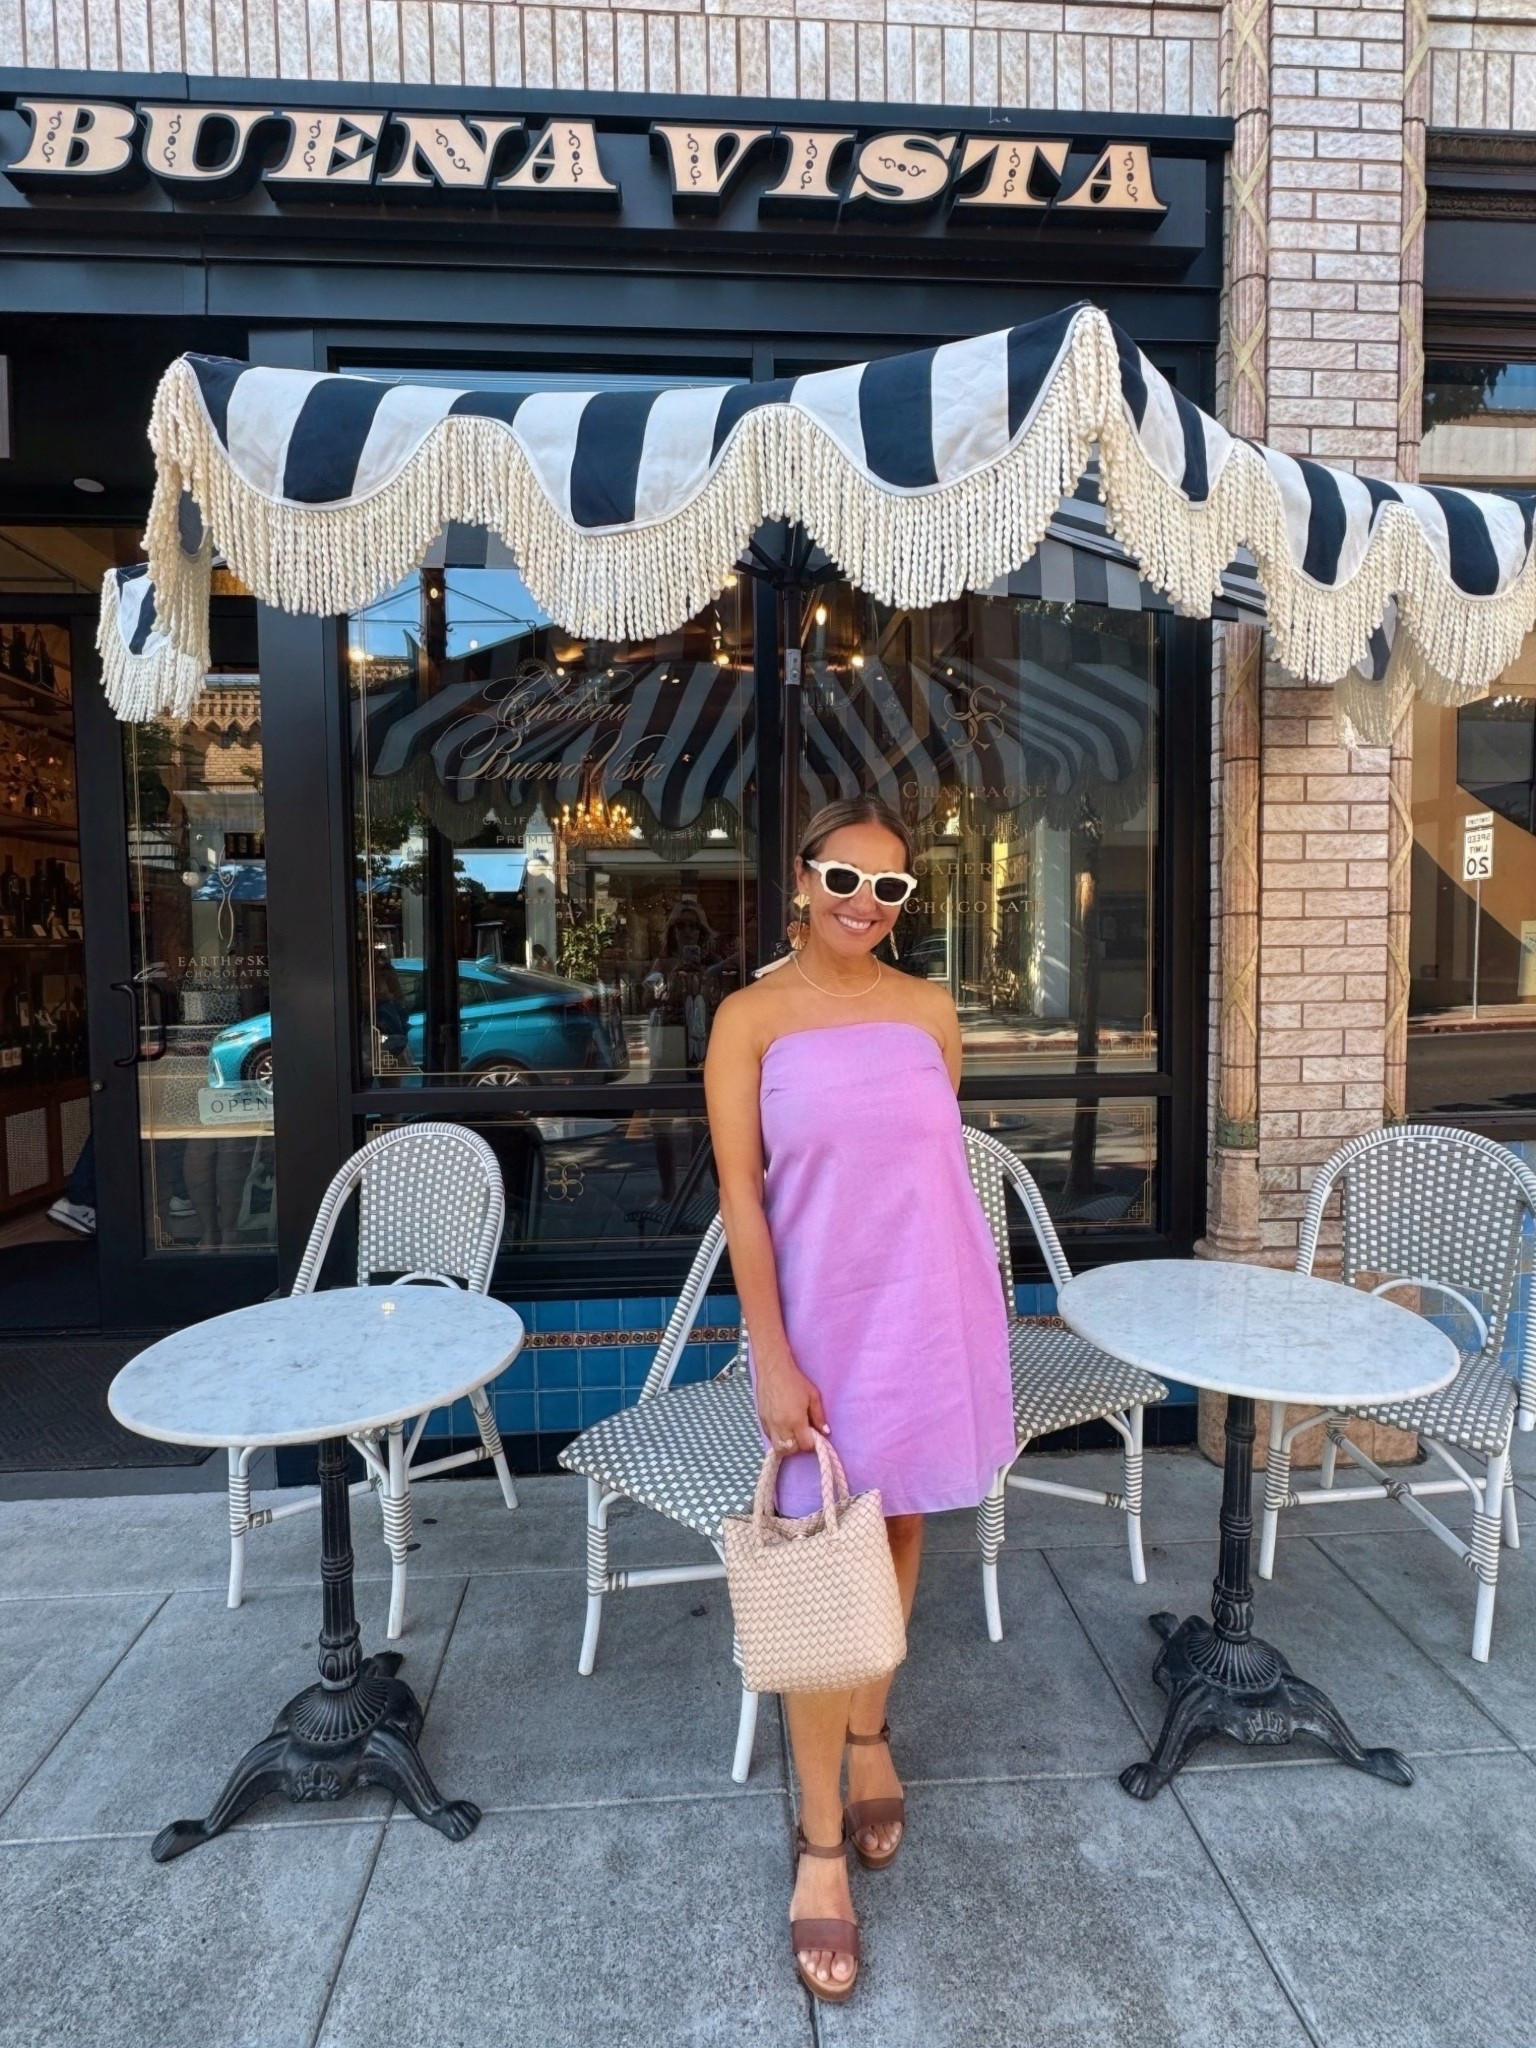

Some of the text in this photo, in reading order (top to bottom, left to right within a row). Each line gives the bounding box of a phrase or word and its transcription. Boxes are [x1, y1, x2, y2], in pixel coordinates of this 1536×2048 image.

[3, 98, 1167, 210] BUENA VISTA
[436, 713, 674, 784] Buena Vista
[902, 781, 1047, 799] CHAMPAGNE
[932, 820, 1020, 837] CAVIAR
[911, 858, 1037, 876] CABERNET
[903, 897, 1046, 914] CHOCOATE
[178, 955, 269, 967] EARTH & SK
[185, 969, 270, 978] CHOCOLATES
[211, 1097, 268, 1113] OPEN
